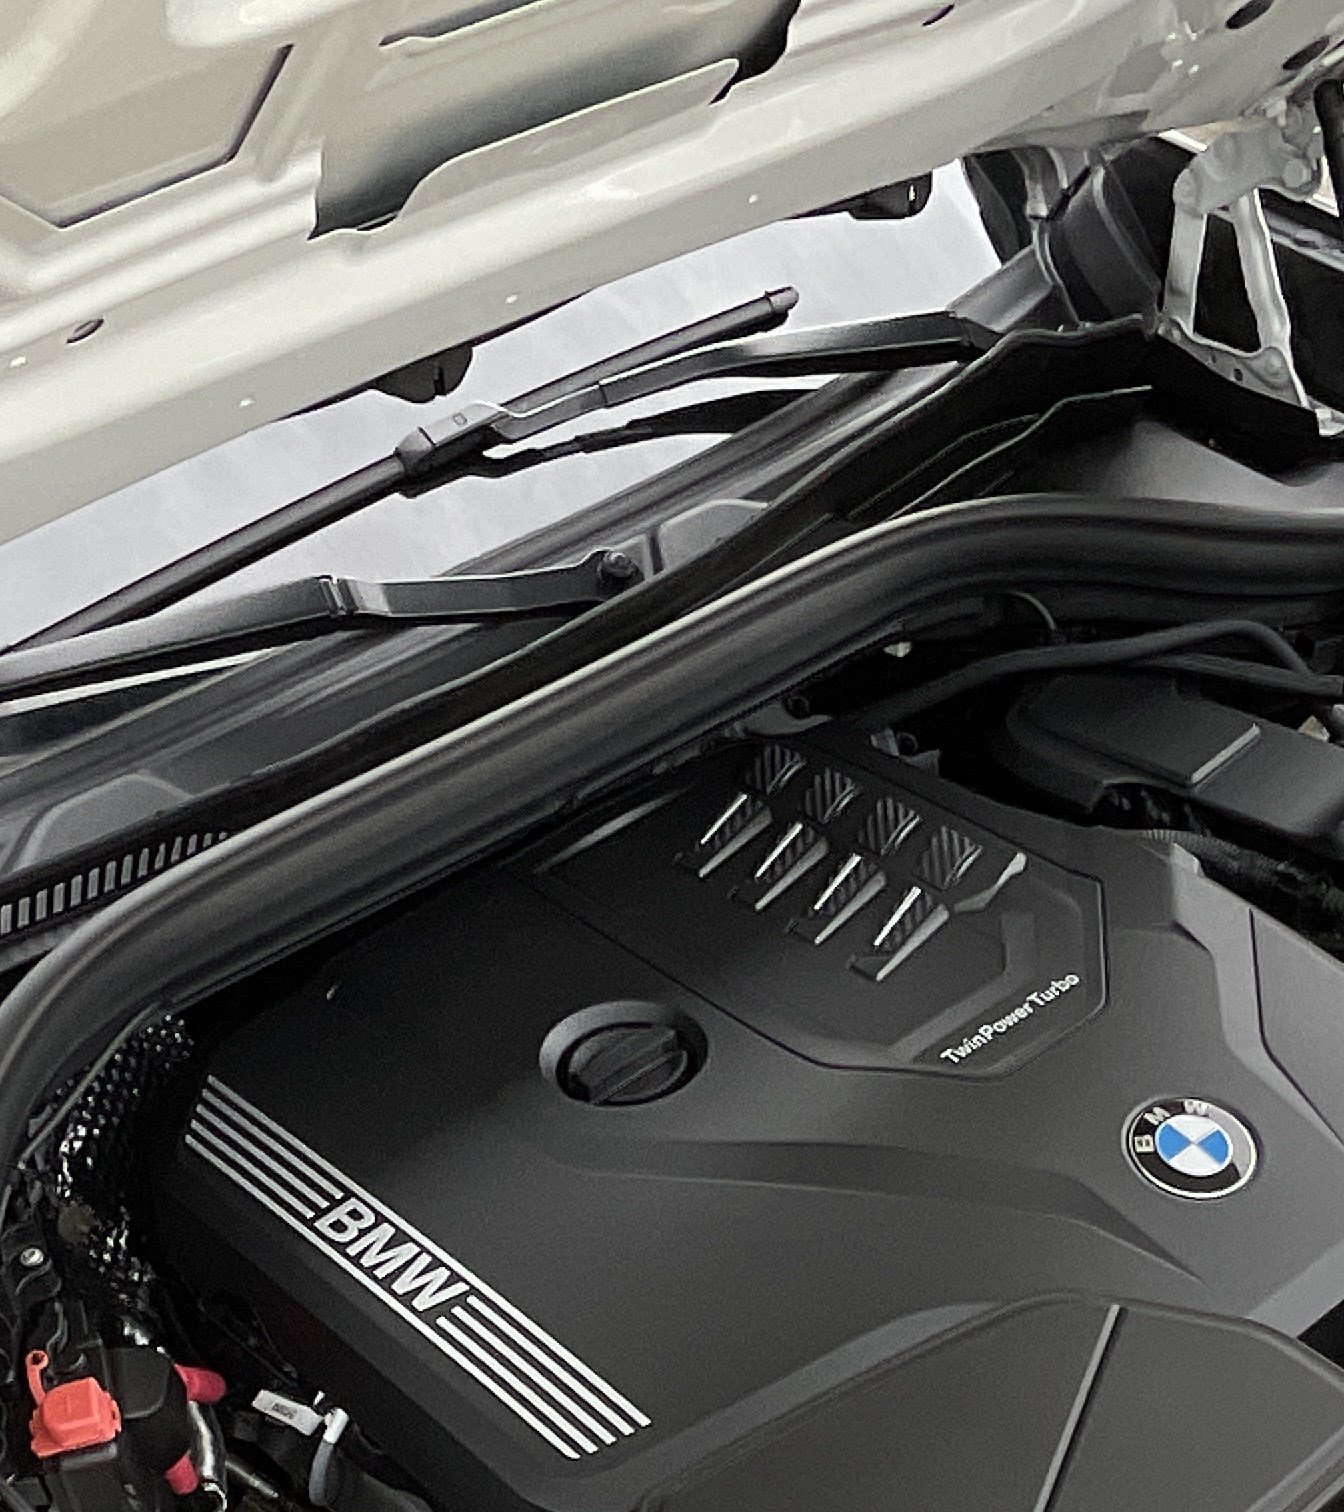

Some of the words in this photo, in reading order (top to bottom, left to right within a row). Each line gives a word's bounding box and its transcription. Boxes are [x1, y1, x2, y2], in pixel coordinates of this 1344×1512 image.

[940, 1002, 1034, 1064] TwinPower
[1026, 974, 1080, 1006] Turbo
[1134, 1099, 1211, 1154] BMW
[314, 1197, 470, 1312] BMW
